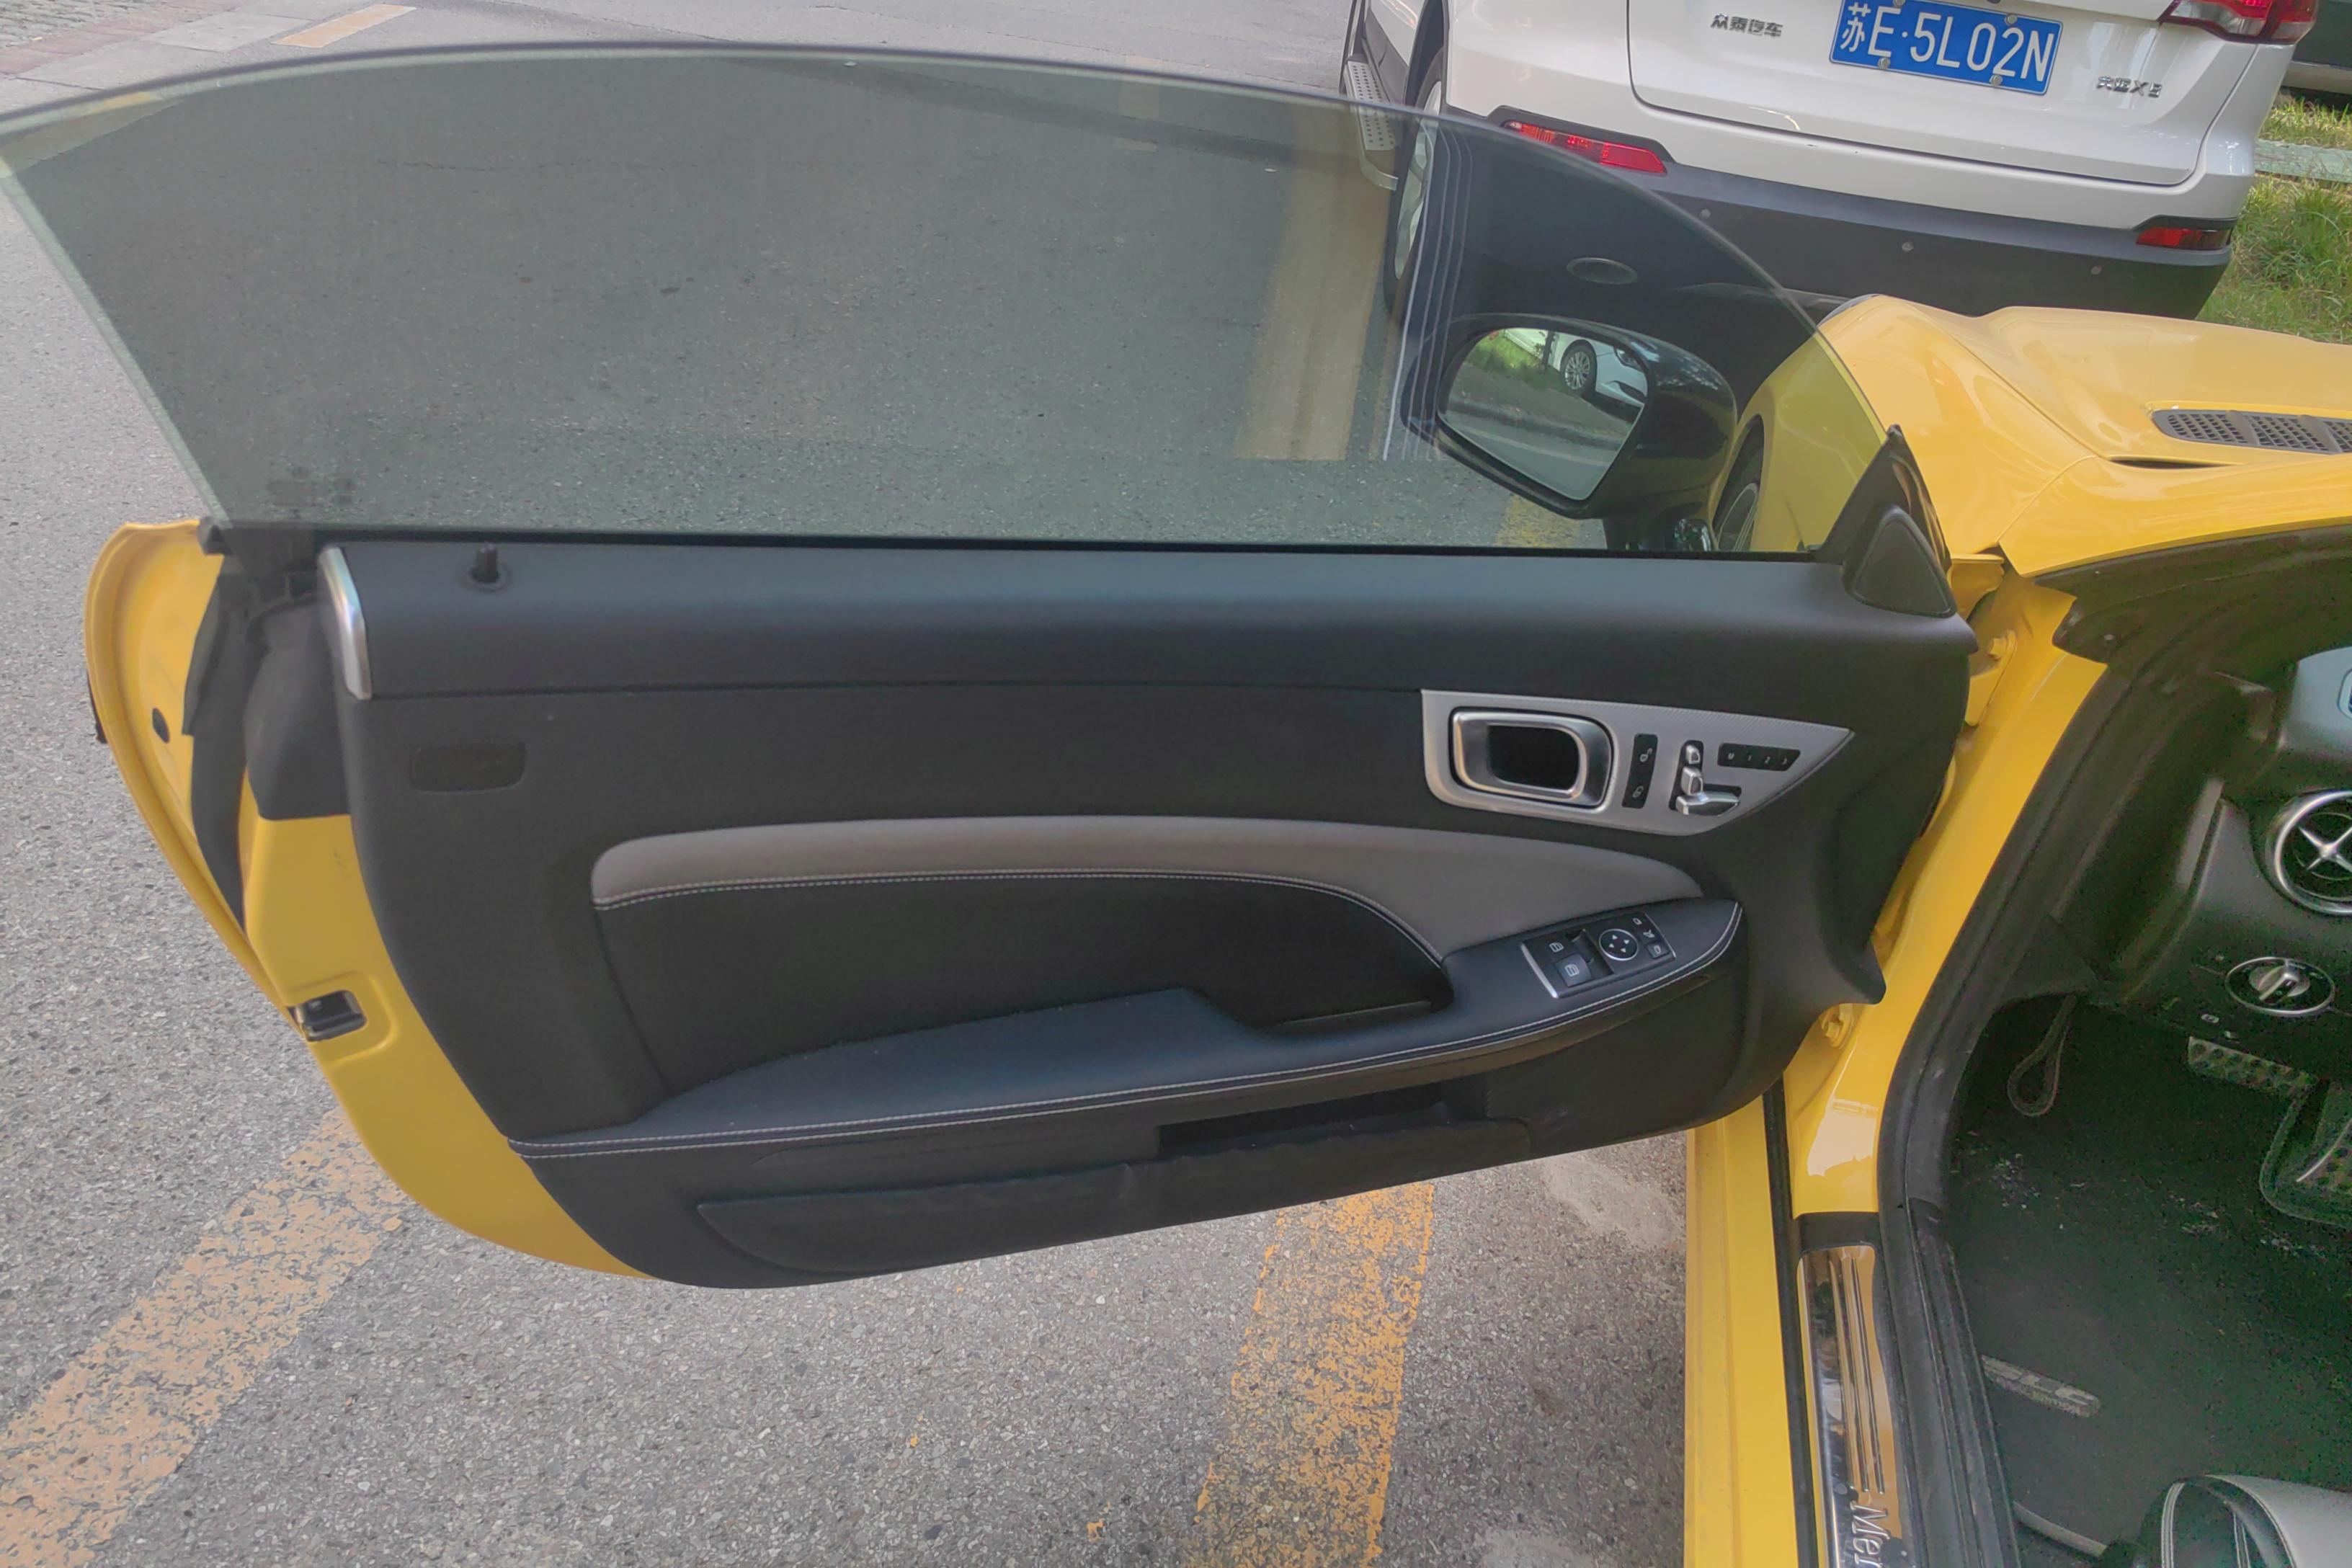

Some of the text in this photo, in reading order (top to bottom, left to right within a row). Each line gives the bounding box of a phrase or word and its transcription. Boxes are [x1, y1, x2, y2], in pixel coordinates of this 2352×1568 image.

[1710, 13, 1783, 37] 众泰汽车
[1840, 2, 2054, 82] 苏E·5L02N
